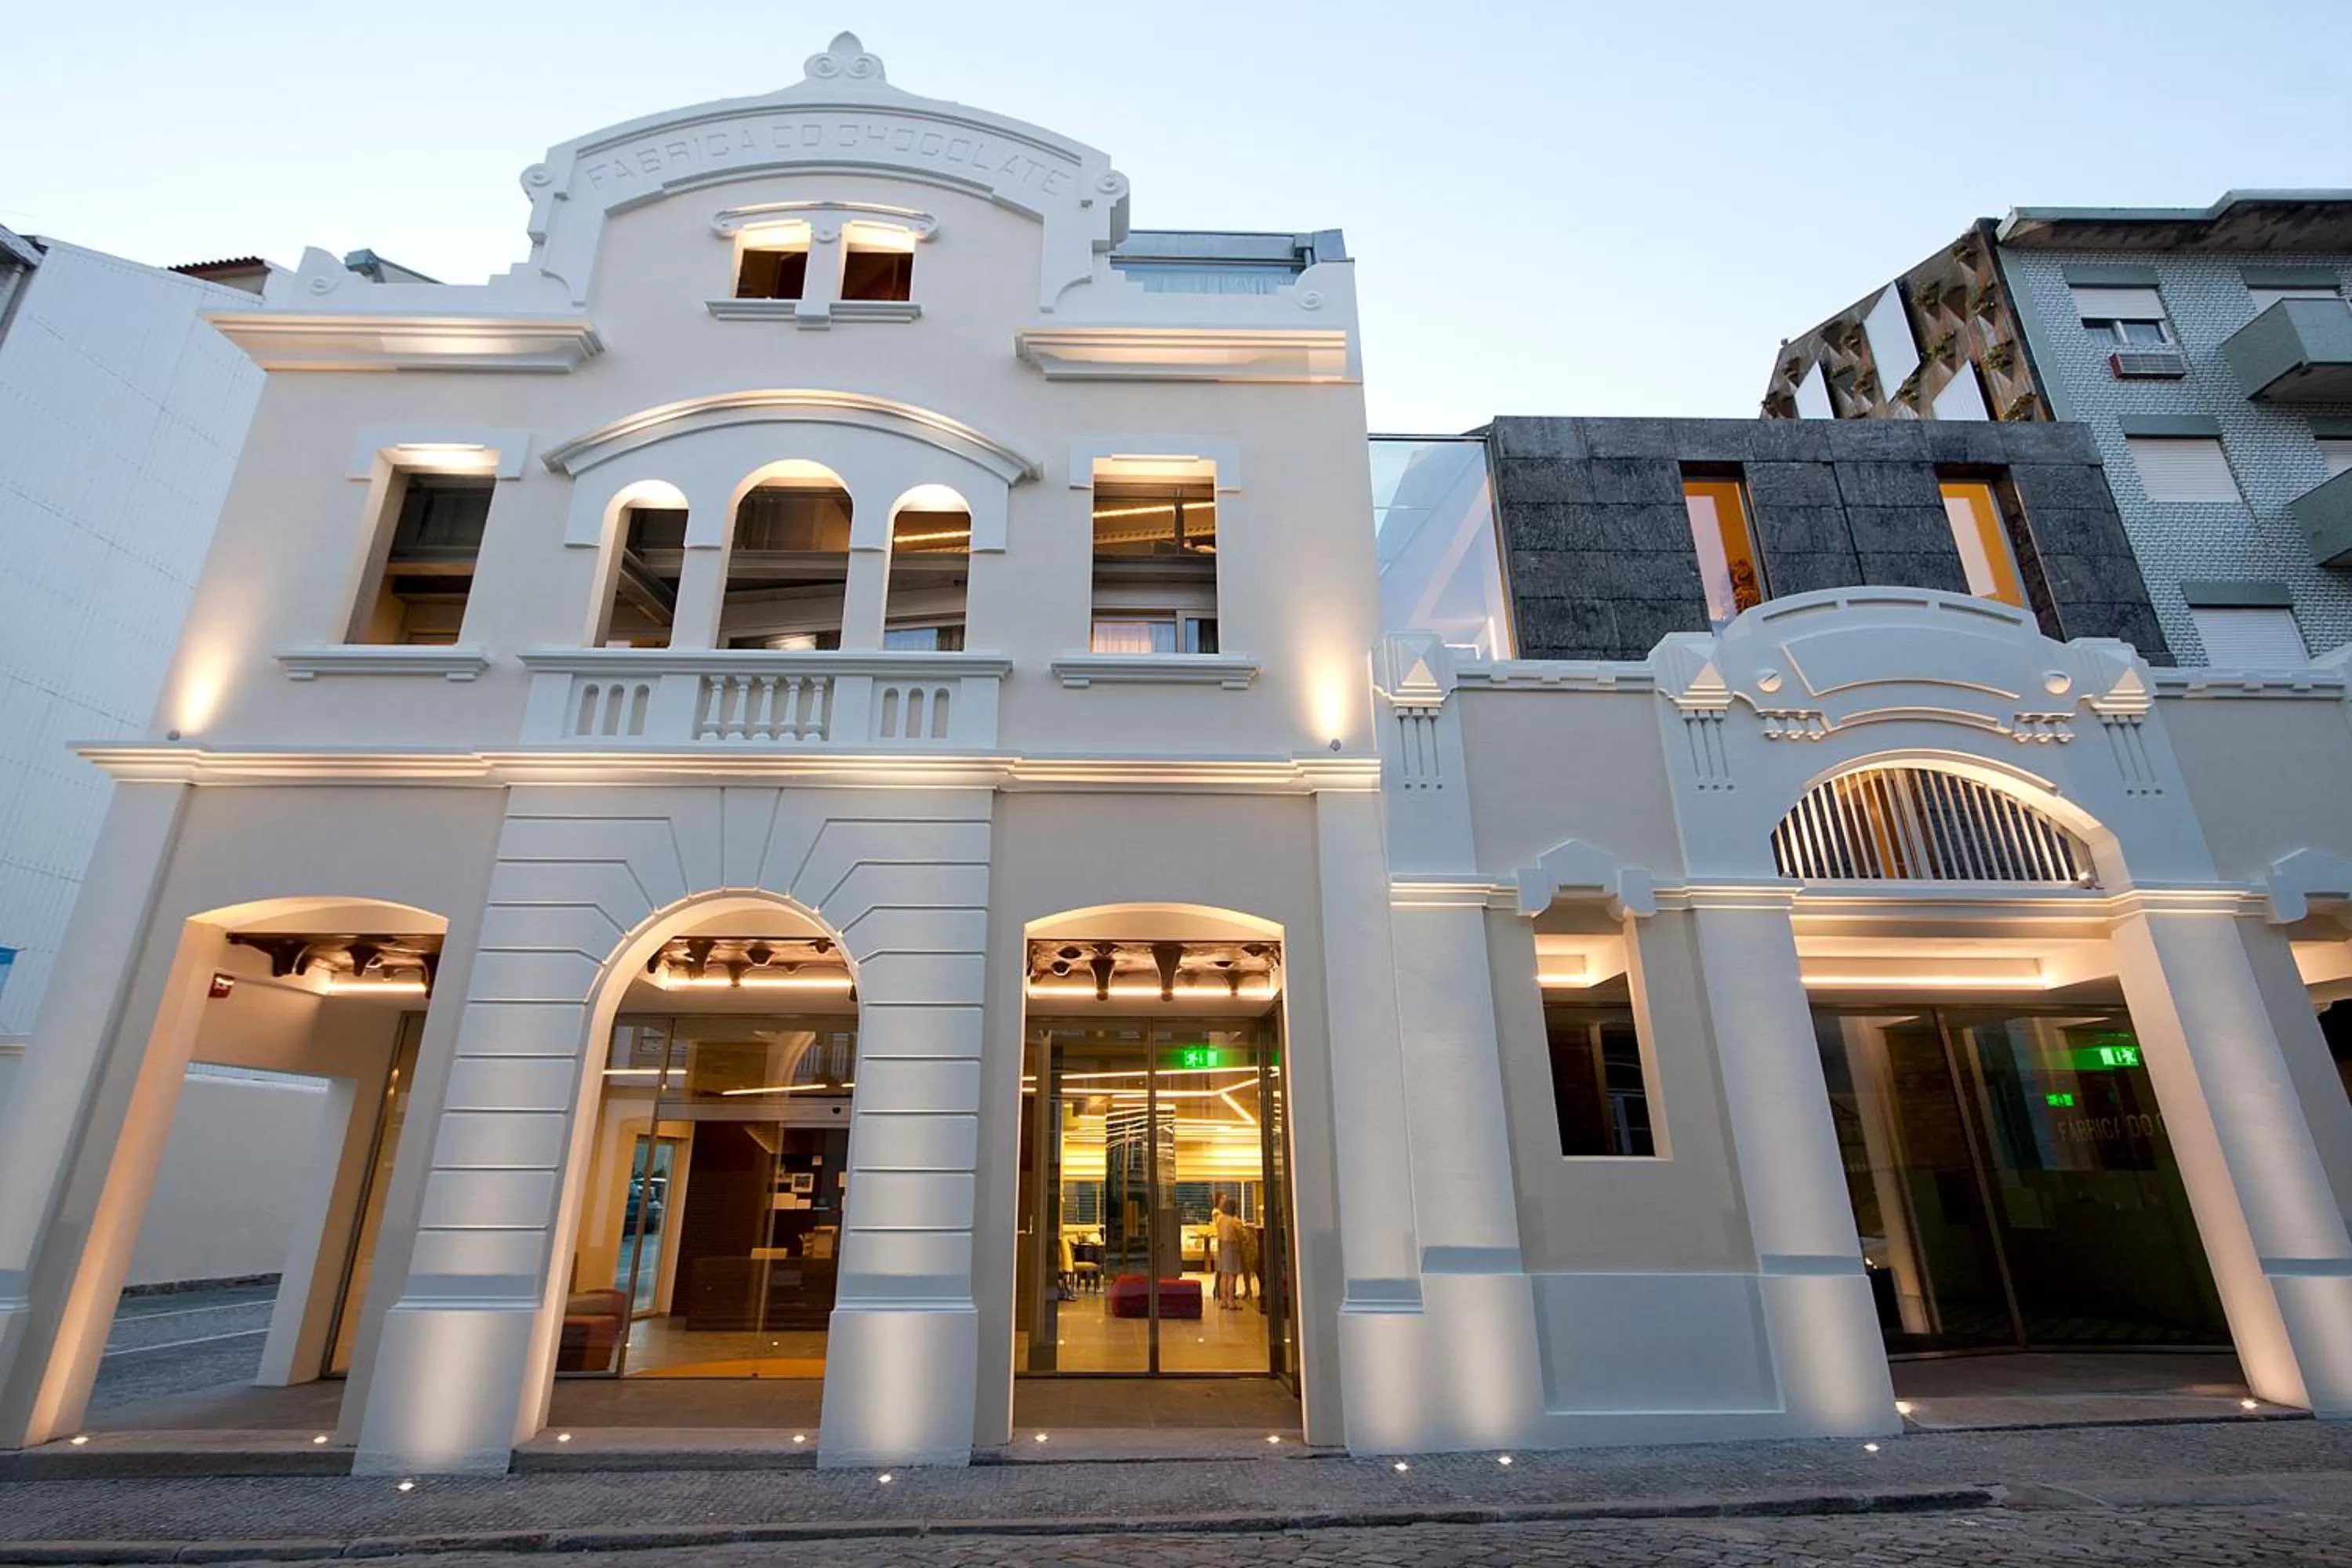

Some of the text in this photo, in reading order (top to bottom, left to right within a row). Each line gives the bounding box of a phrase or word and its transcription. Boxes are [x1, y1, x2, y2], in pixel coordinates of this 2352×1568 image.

[771, 123, 822, 149] DO
[837, 123, 1071, 197] CHOCOLATE
[2125, 1113, 2154, 1138] DO
